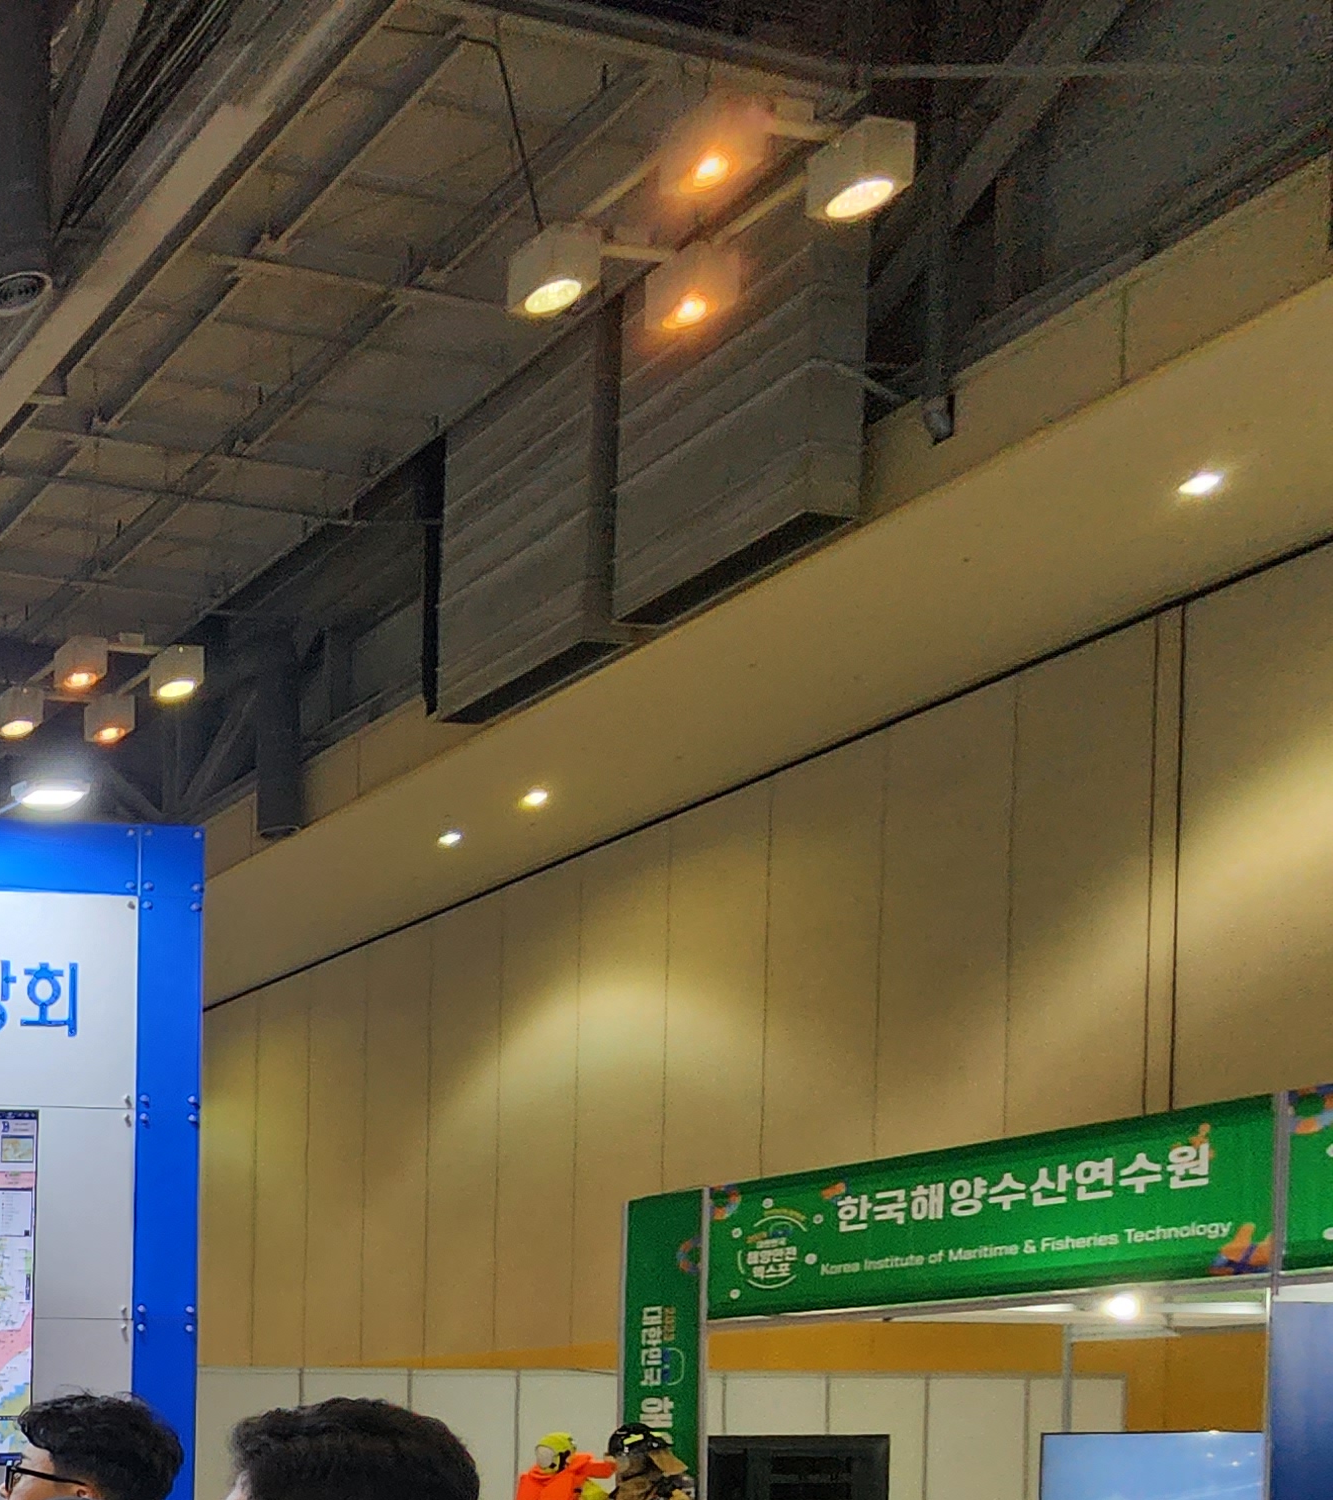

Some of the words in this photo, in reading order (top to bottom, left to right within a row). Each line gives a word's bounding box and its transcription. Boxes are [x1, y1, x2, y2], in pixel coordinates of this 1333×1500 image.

[836, 1143, 1210, 1233] 한국해양수산연수원
[820, 1262, 860, 1277] Korea
[864, 1253, 924, 1270] Institute
[928, 1250, 945, 1265] of
[948, 1243, 1019, 1262] Maritime
[1023, 1239, 1037, 1254] &
[1041, 1233, 1119, 1253] Fisheries
[1125, 1220, 1233, 1244] Technology
[640, 1305, 663, 1386] 대한민국
[639, 1395, 674, 1445] 해
